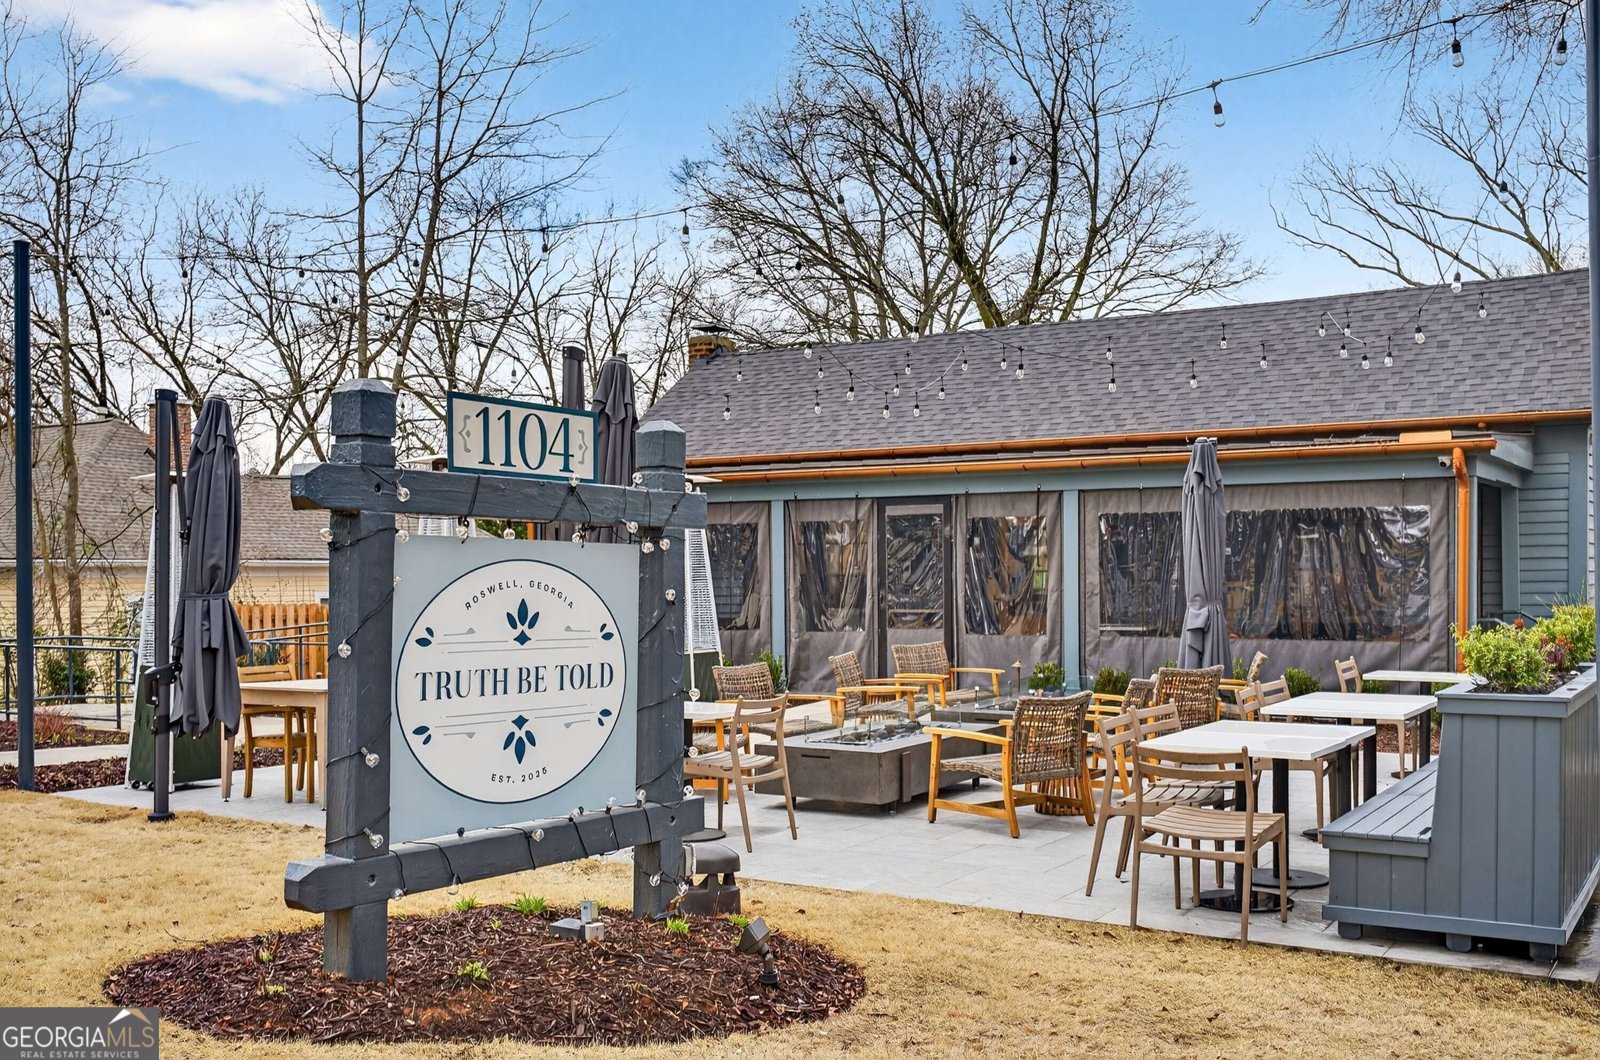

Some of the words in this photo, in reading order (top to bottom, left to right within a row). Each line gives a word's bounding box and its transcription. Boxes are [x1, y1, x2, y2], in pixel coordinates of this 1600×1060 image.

[475, 406, 575, 473] 1104
[465, 579, 523, 610] ROSWELL,
[529, 580, 574, 609] GEORGIA
[414, 667, 509, 702] TRUTH
[516, 665, 548, 695] BE
[554, 662, 614, 691] TOLD
[491, 773, 515, 784] EST.
